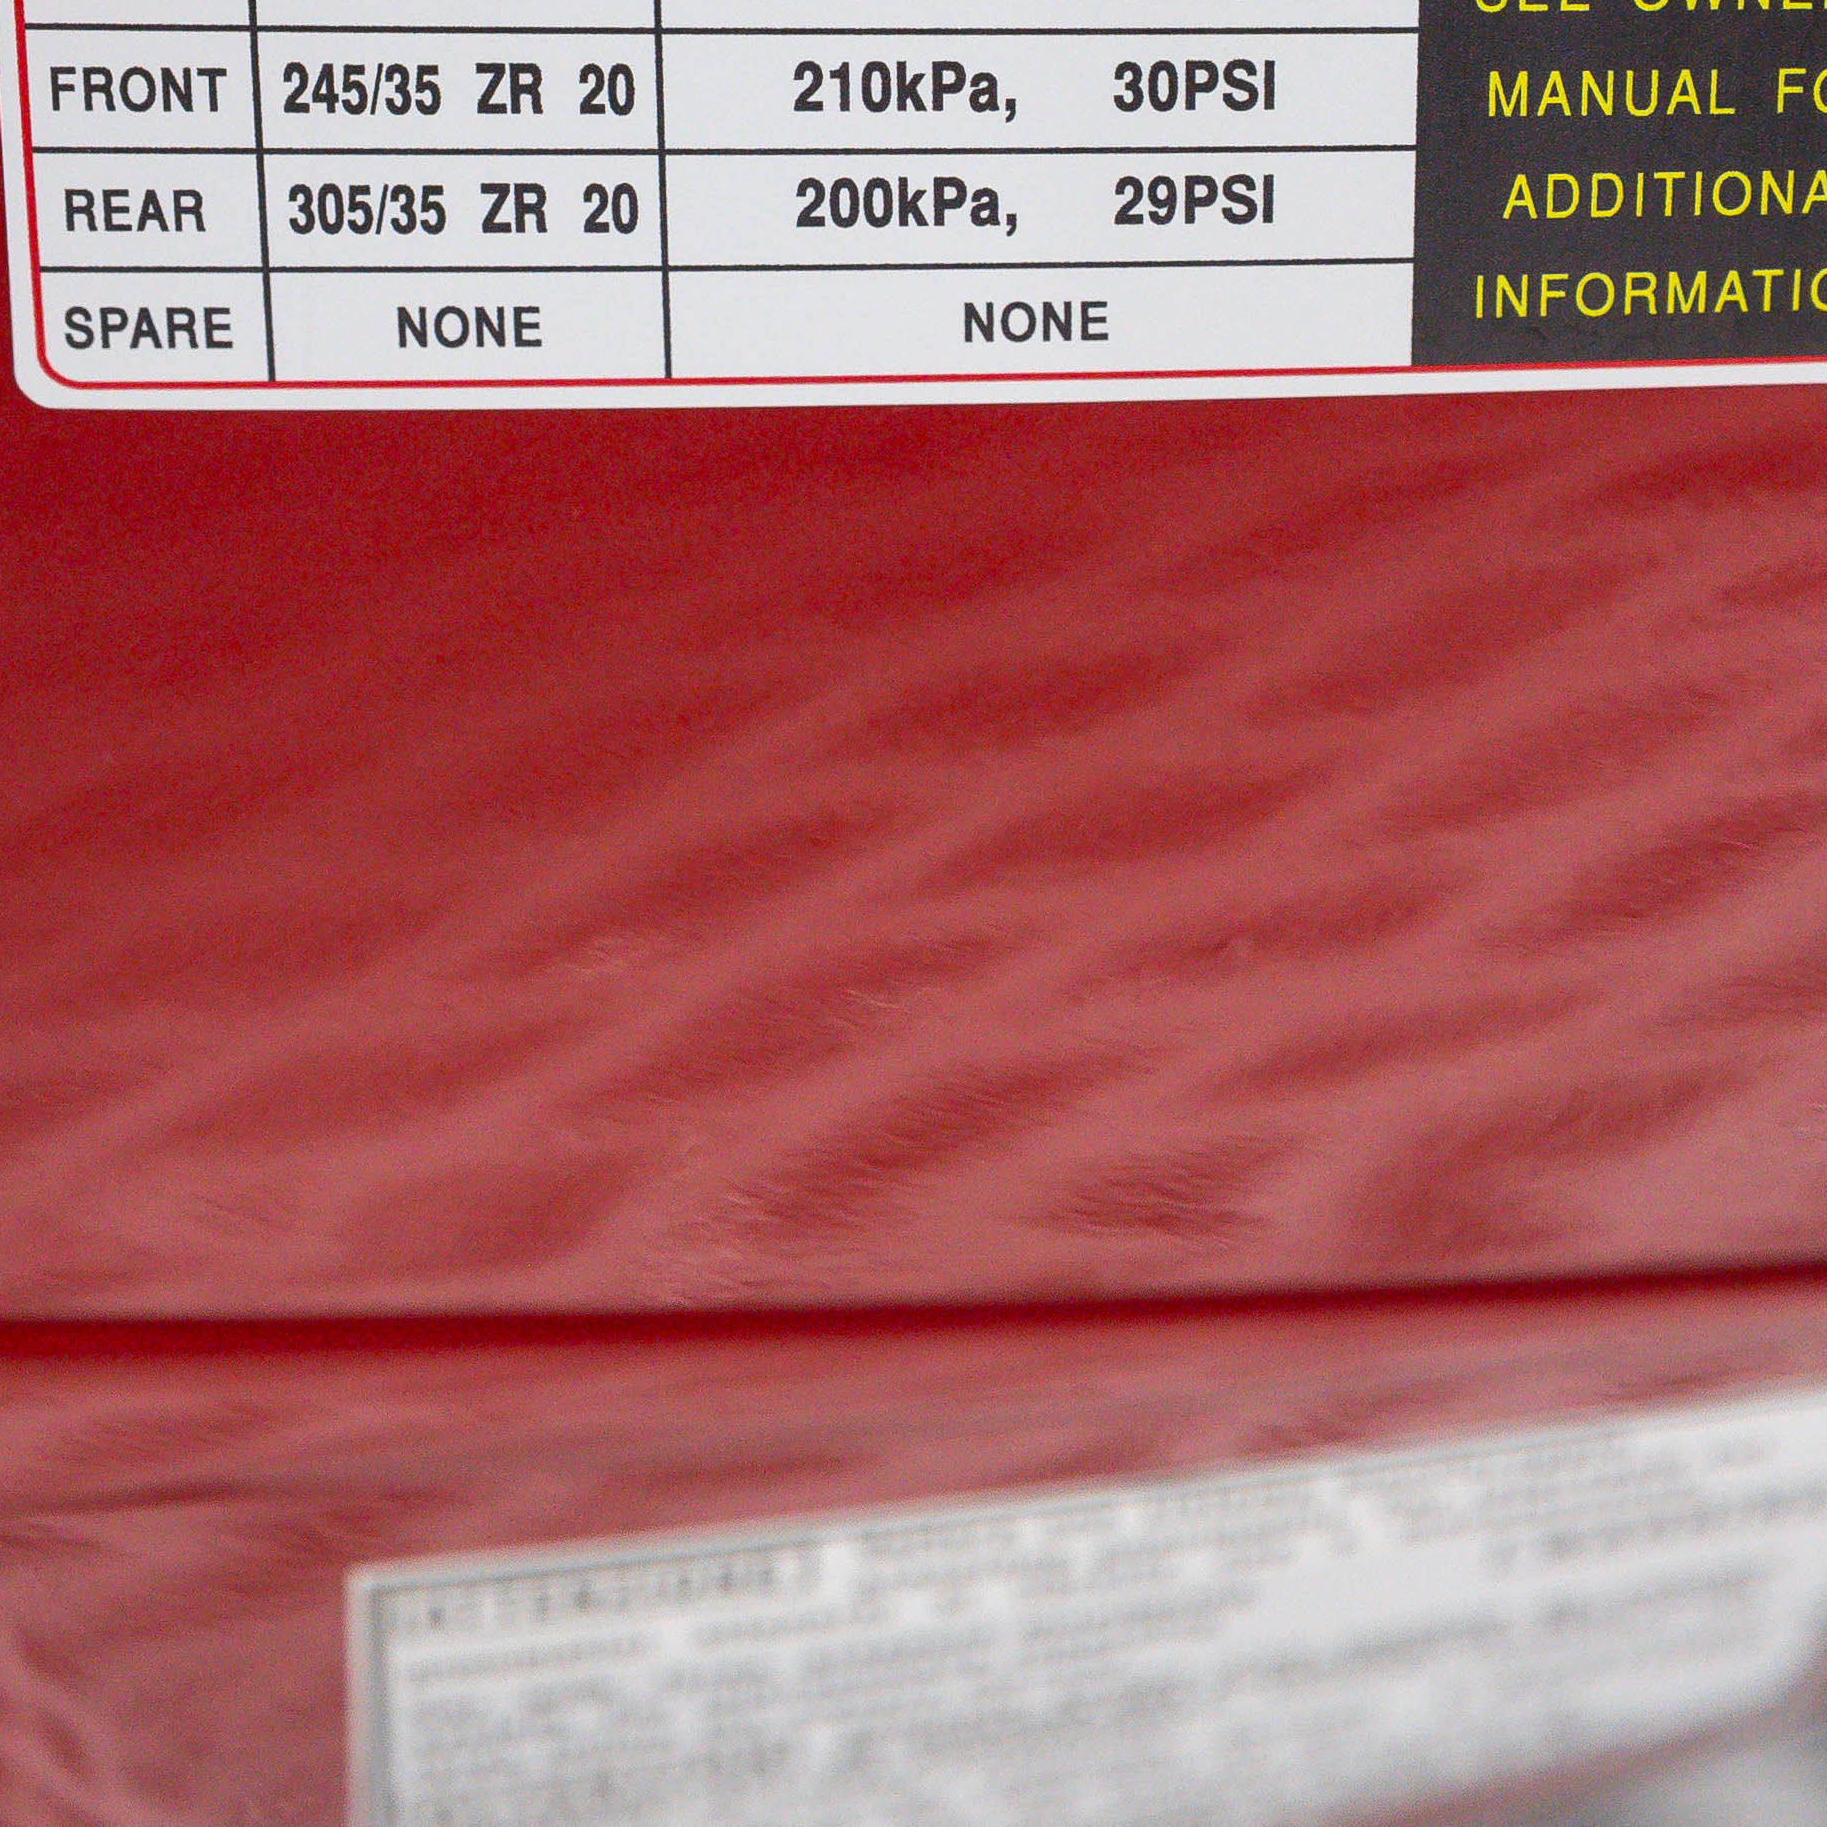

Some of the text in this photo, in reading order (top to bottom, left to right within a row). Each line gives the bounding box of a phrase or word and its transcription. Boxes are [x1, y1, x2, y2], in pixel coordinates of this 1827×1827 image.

[49, 66, 228, 113] FRONT
[283, 62, 635, 116] 245/35 ZR 20
[793, 58, 1276, 123] 210kPa, 30PSI
[1488, 68, 1737, 118] MANUAL
[64, 188, 206, 232] REAR
[288, 182, 639, 235] 305/35 ZR 20
[796, 173, 1274, 237] 200kPa, 29PSI
[64, 306, 233, 350] SPARE
[397, 305, 542, 349] NONE
[964, 300, 1109, 343] NONE
